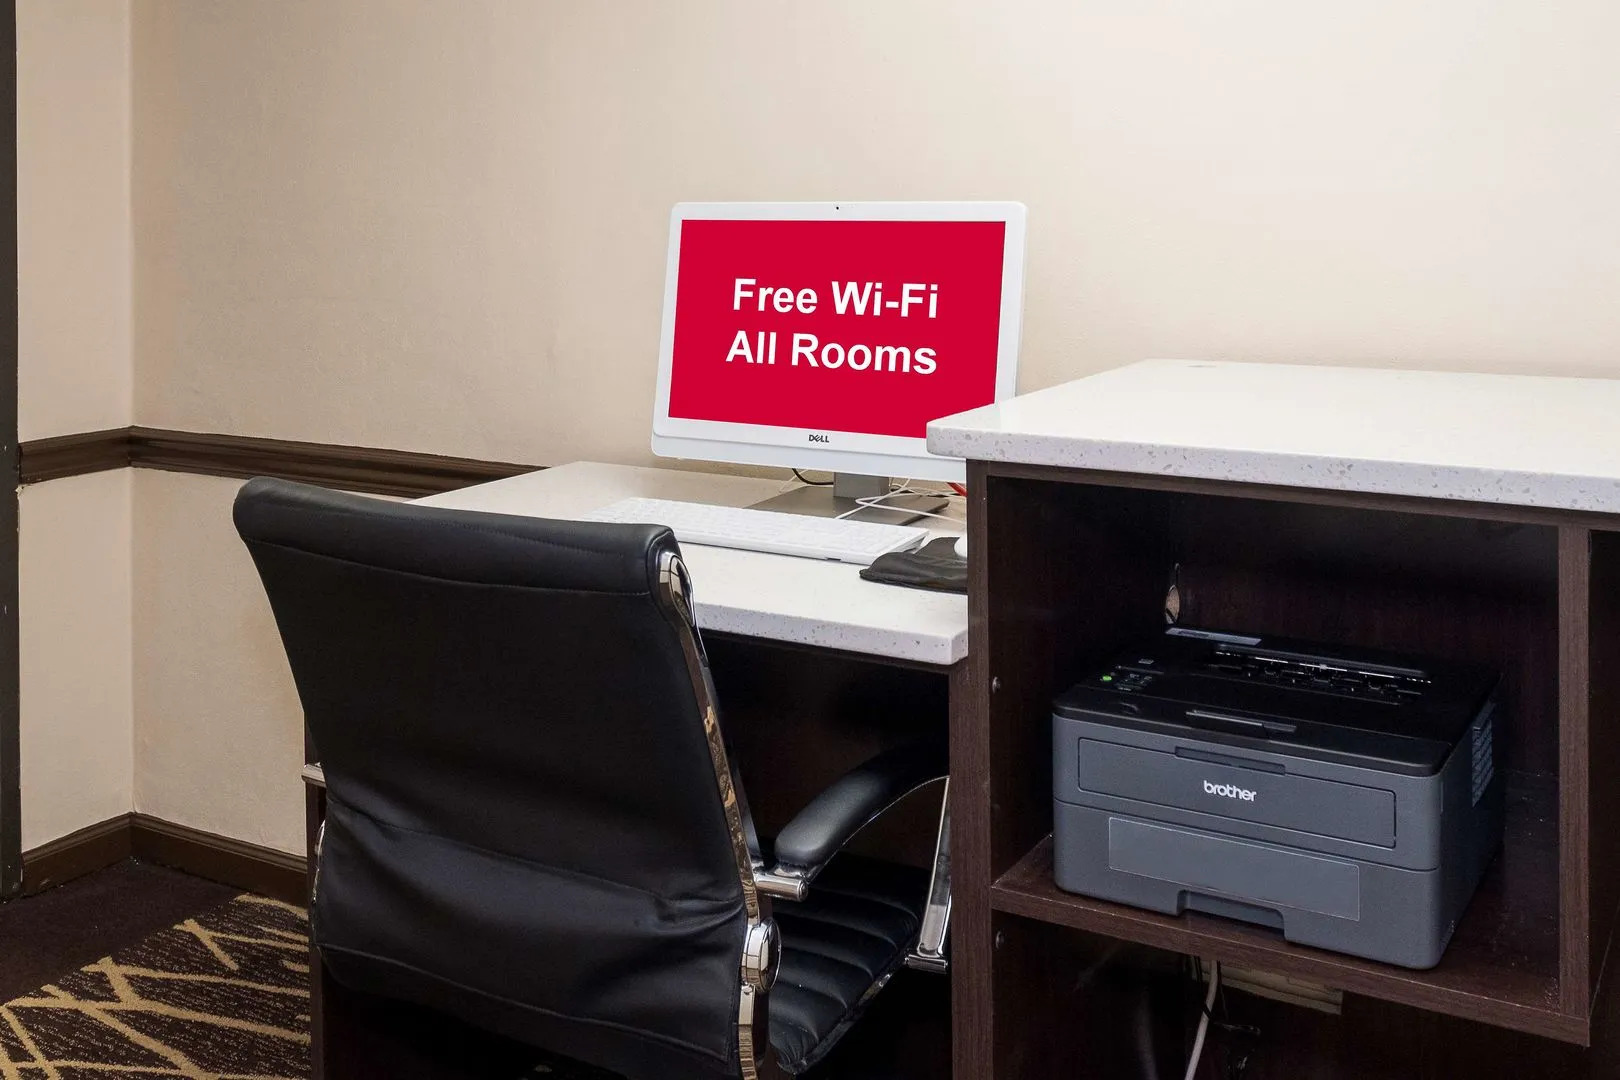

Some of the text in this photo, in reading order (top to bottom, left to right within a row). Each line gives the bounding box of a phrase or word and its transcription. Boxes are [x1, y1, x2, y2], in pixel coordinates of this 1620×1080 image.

[733, 278, 938, 319] Free Wi-Fi
[725, 330, 937, 375] All Rooms
[808, 434, 830, 443] DELL
[1203, 780, 1257, 802] brother
